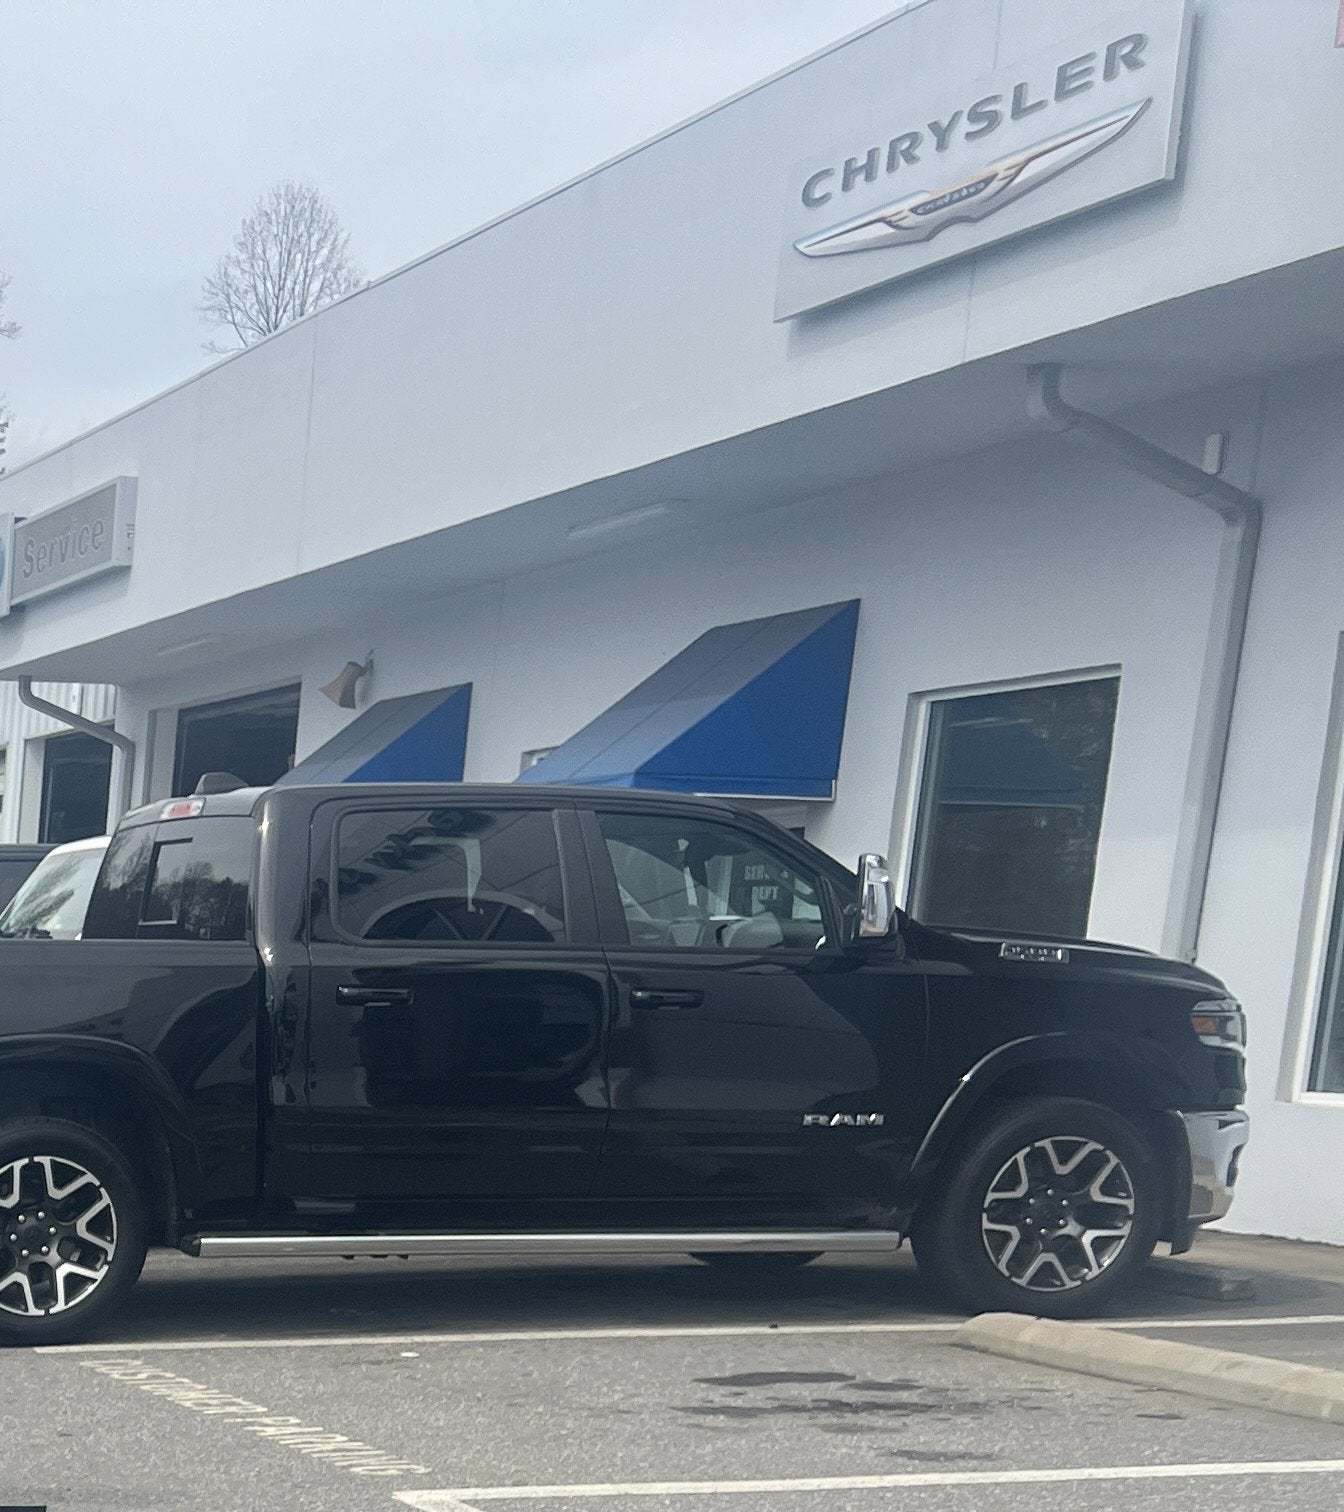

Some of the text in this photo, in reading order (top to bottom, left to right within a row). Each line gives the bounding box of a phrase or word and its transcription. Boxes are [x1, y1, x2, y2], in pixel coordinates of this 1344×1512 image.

[801, 32, 1148, 208] CHRYSLER
[23, 520, 104, 579] Service
[803, 1113, 884, 1126] RAM
[79, 1359, 433, 1475] CUSTOMER PARKING
